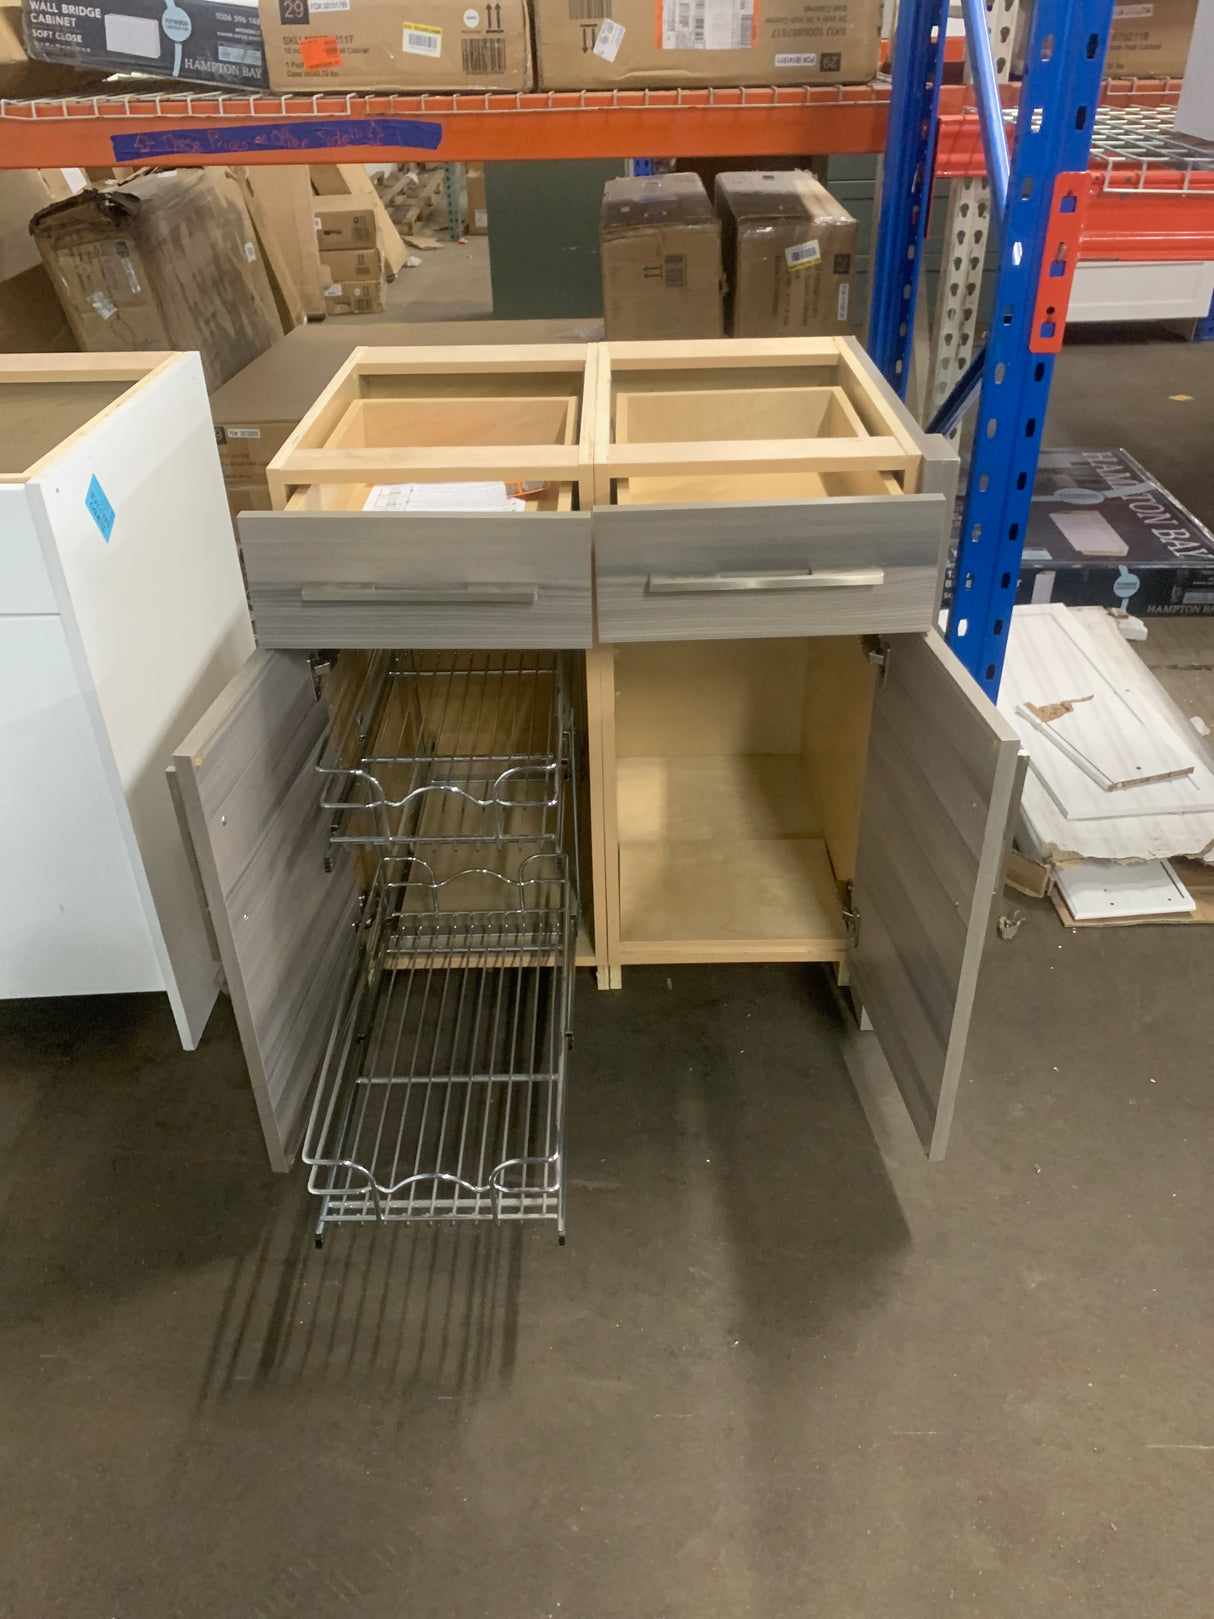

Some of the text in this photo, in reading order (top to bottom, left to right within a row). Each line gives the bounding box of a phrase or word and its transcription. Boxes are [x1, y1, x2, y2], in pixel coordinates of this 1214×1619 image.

[29, 1, 102, 18] WALL BRIDGE
[283, 0, 304, 18] 29
[30, 13, 76, 27] CABINET
[32, 29, 82, 43] SOFT CLOSE
[184, 58, 262, 79] HAMPTON BAY
[822, 55, 838, 69] 29
[206, 128, 249, 151] Prices
[271, 126, 308, 149] Other
[1081, 451, 1214, 560] HAMTON BAY
[1146, 603, 1201, 615] HAMPTON
